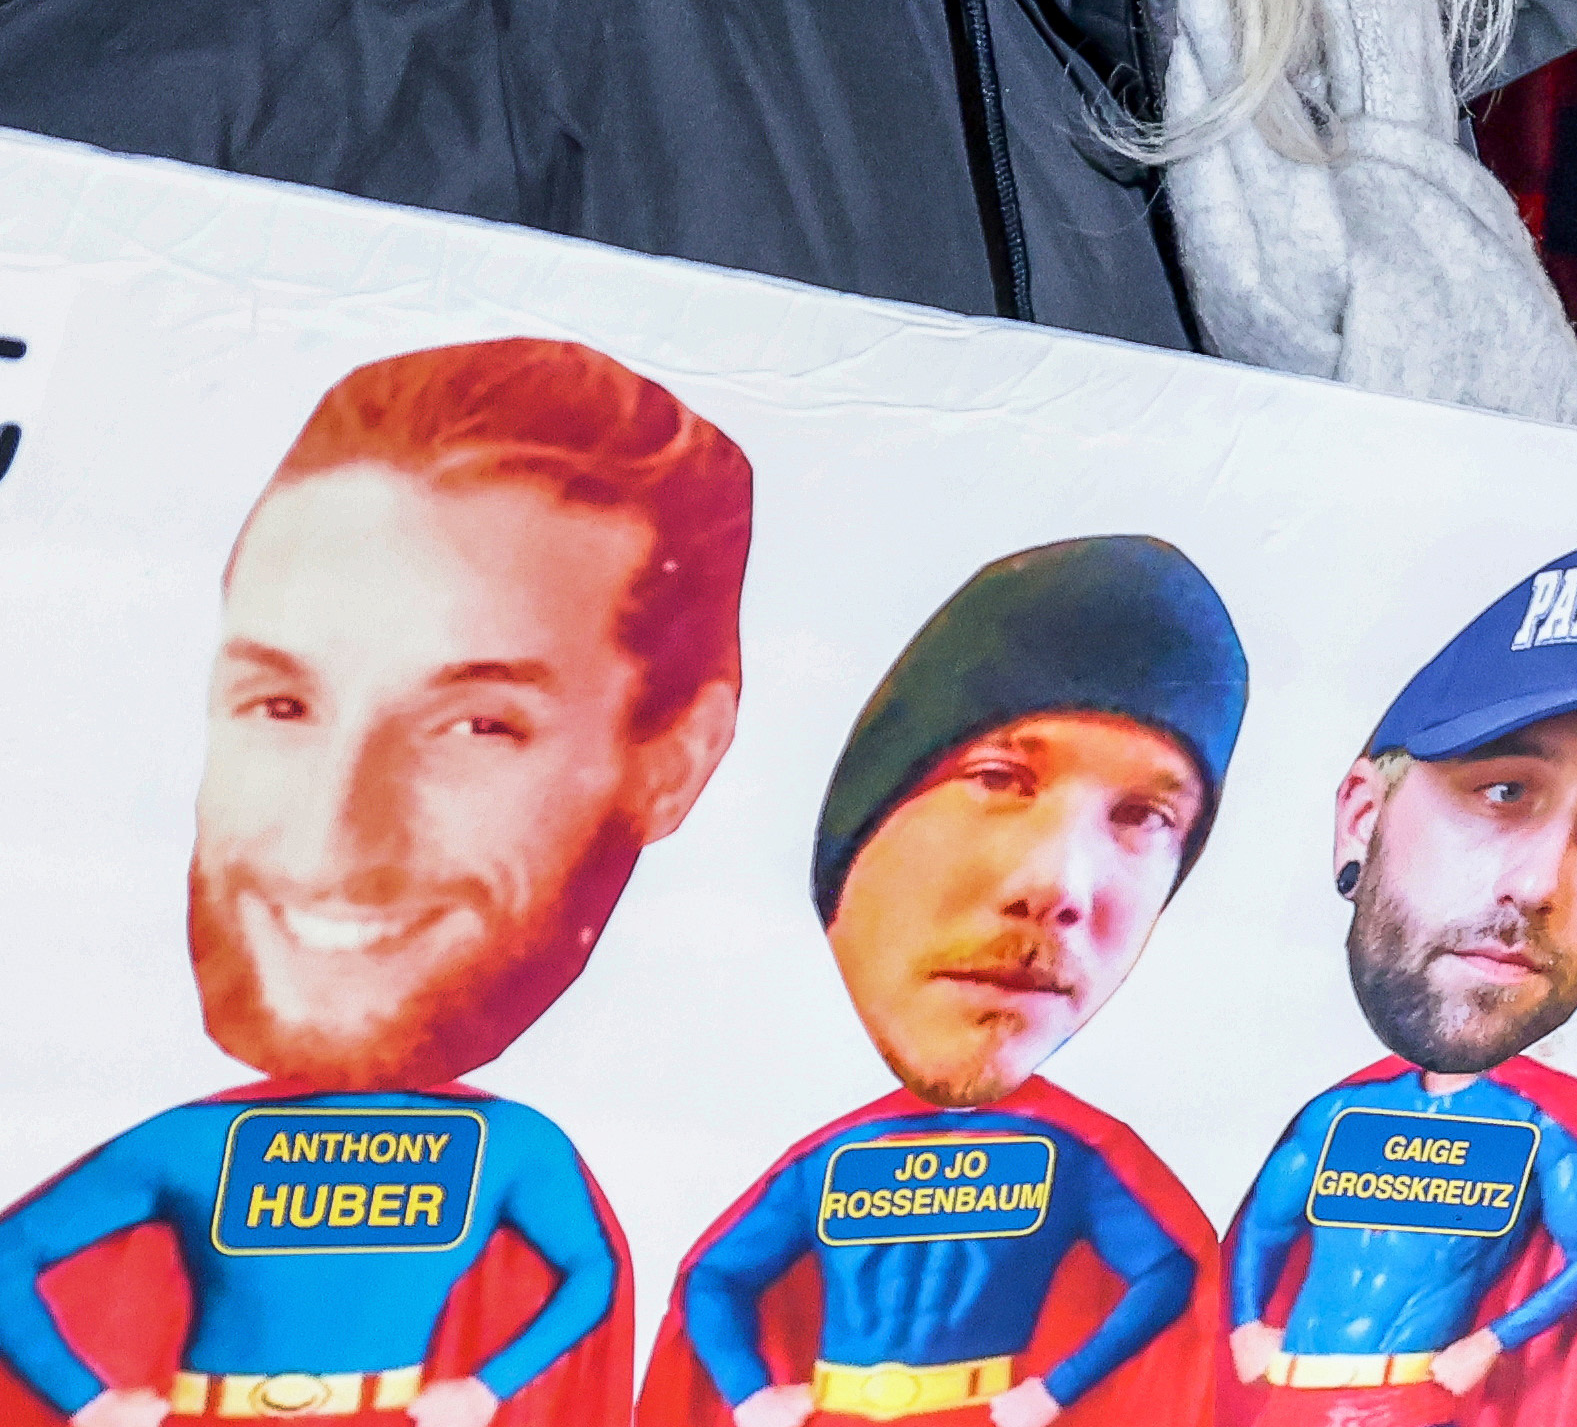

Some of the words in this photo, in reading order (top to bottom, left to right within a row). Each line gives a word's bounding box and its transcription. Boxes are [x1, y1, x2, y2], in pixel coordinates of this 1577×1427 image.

[263, 1131, 450, 1163] ANTHONY
[1383, 1135, 1471, 1165] GAIGE
[894, 1152, 940, 1181] JO
[943, 1149, 988, 1179] JO
[246, 1184, 446, 1228] HUBER
[823, 1182, 1047, 1220] ROSSENBAUM
[1316, 1170, 1515, 1209] GROSSKREUTZ
